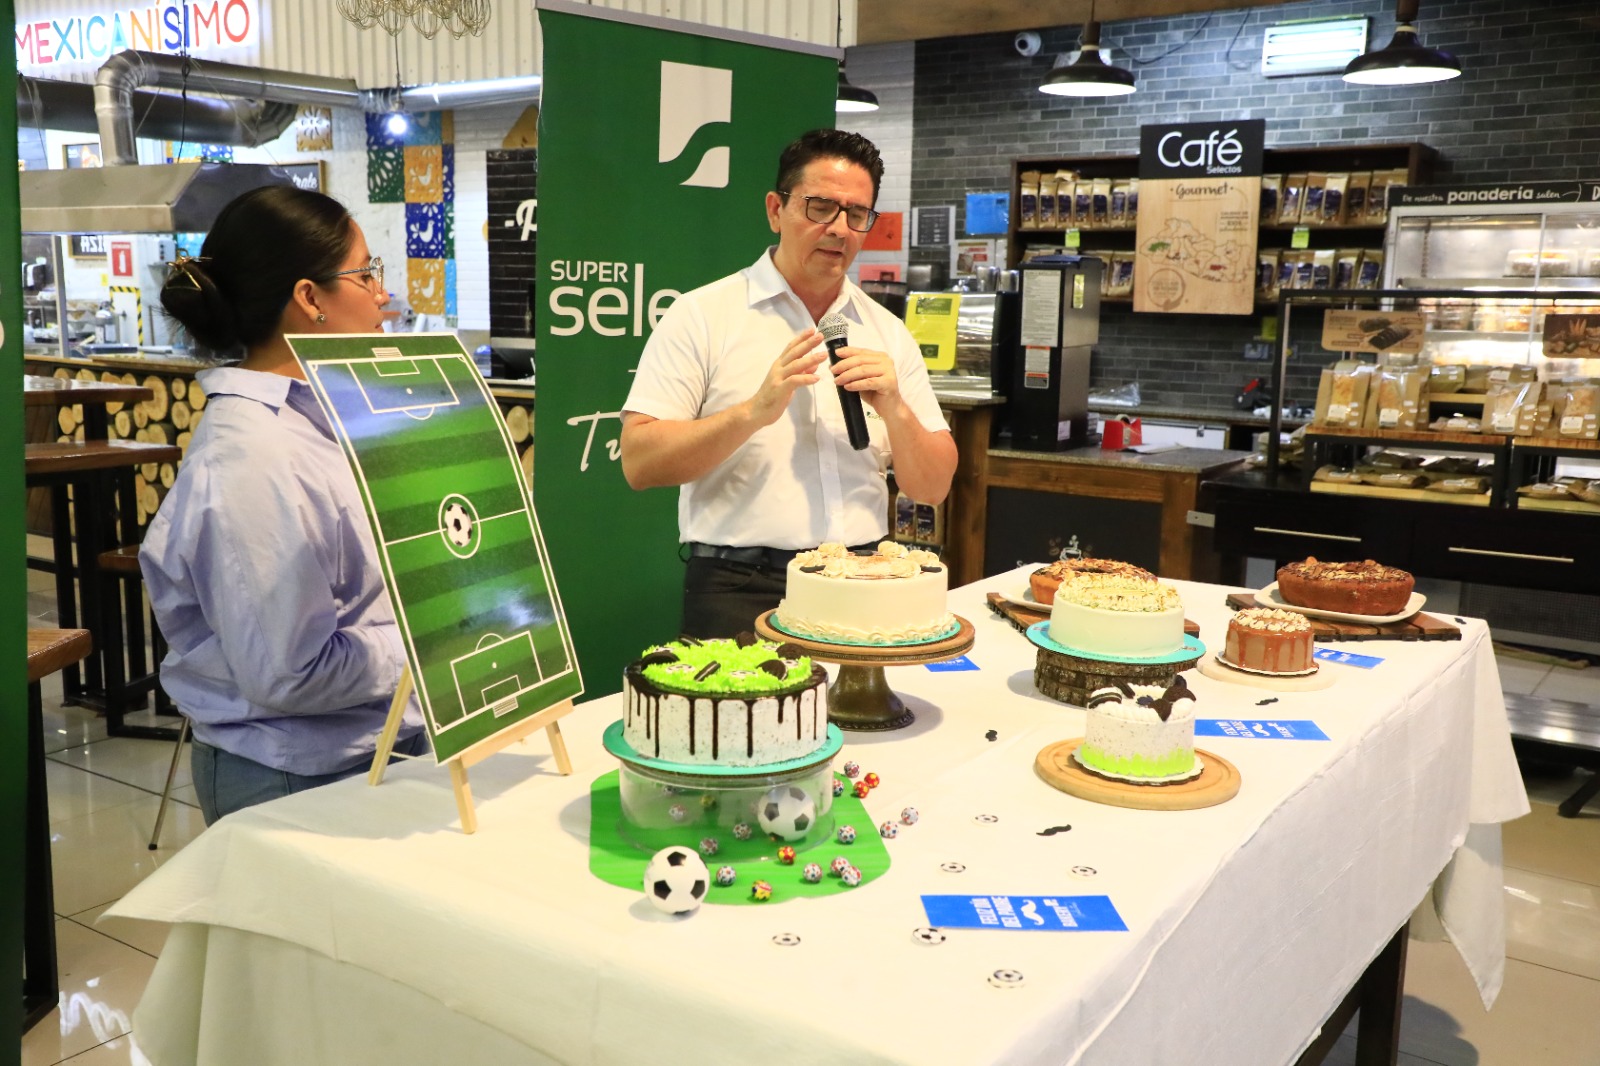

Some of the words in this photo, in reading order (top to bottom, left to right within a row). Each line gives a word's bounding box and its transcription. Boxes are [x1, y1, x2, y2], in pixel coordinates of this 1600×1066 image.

[1158, 128, 1243, 167] Café
[1206, 165, 1242, 174] Selectos
[1175, 182, 1229, 199] Gourmet
[1447, 186, 1534, 204] panadería
[550, 260, 628, 283] SUPER
